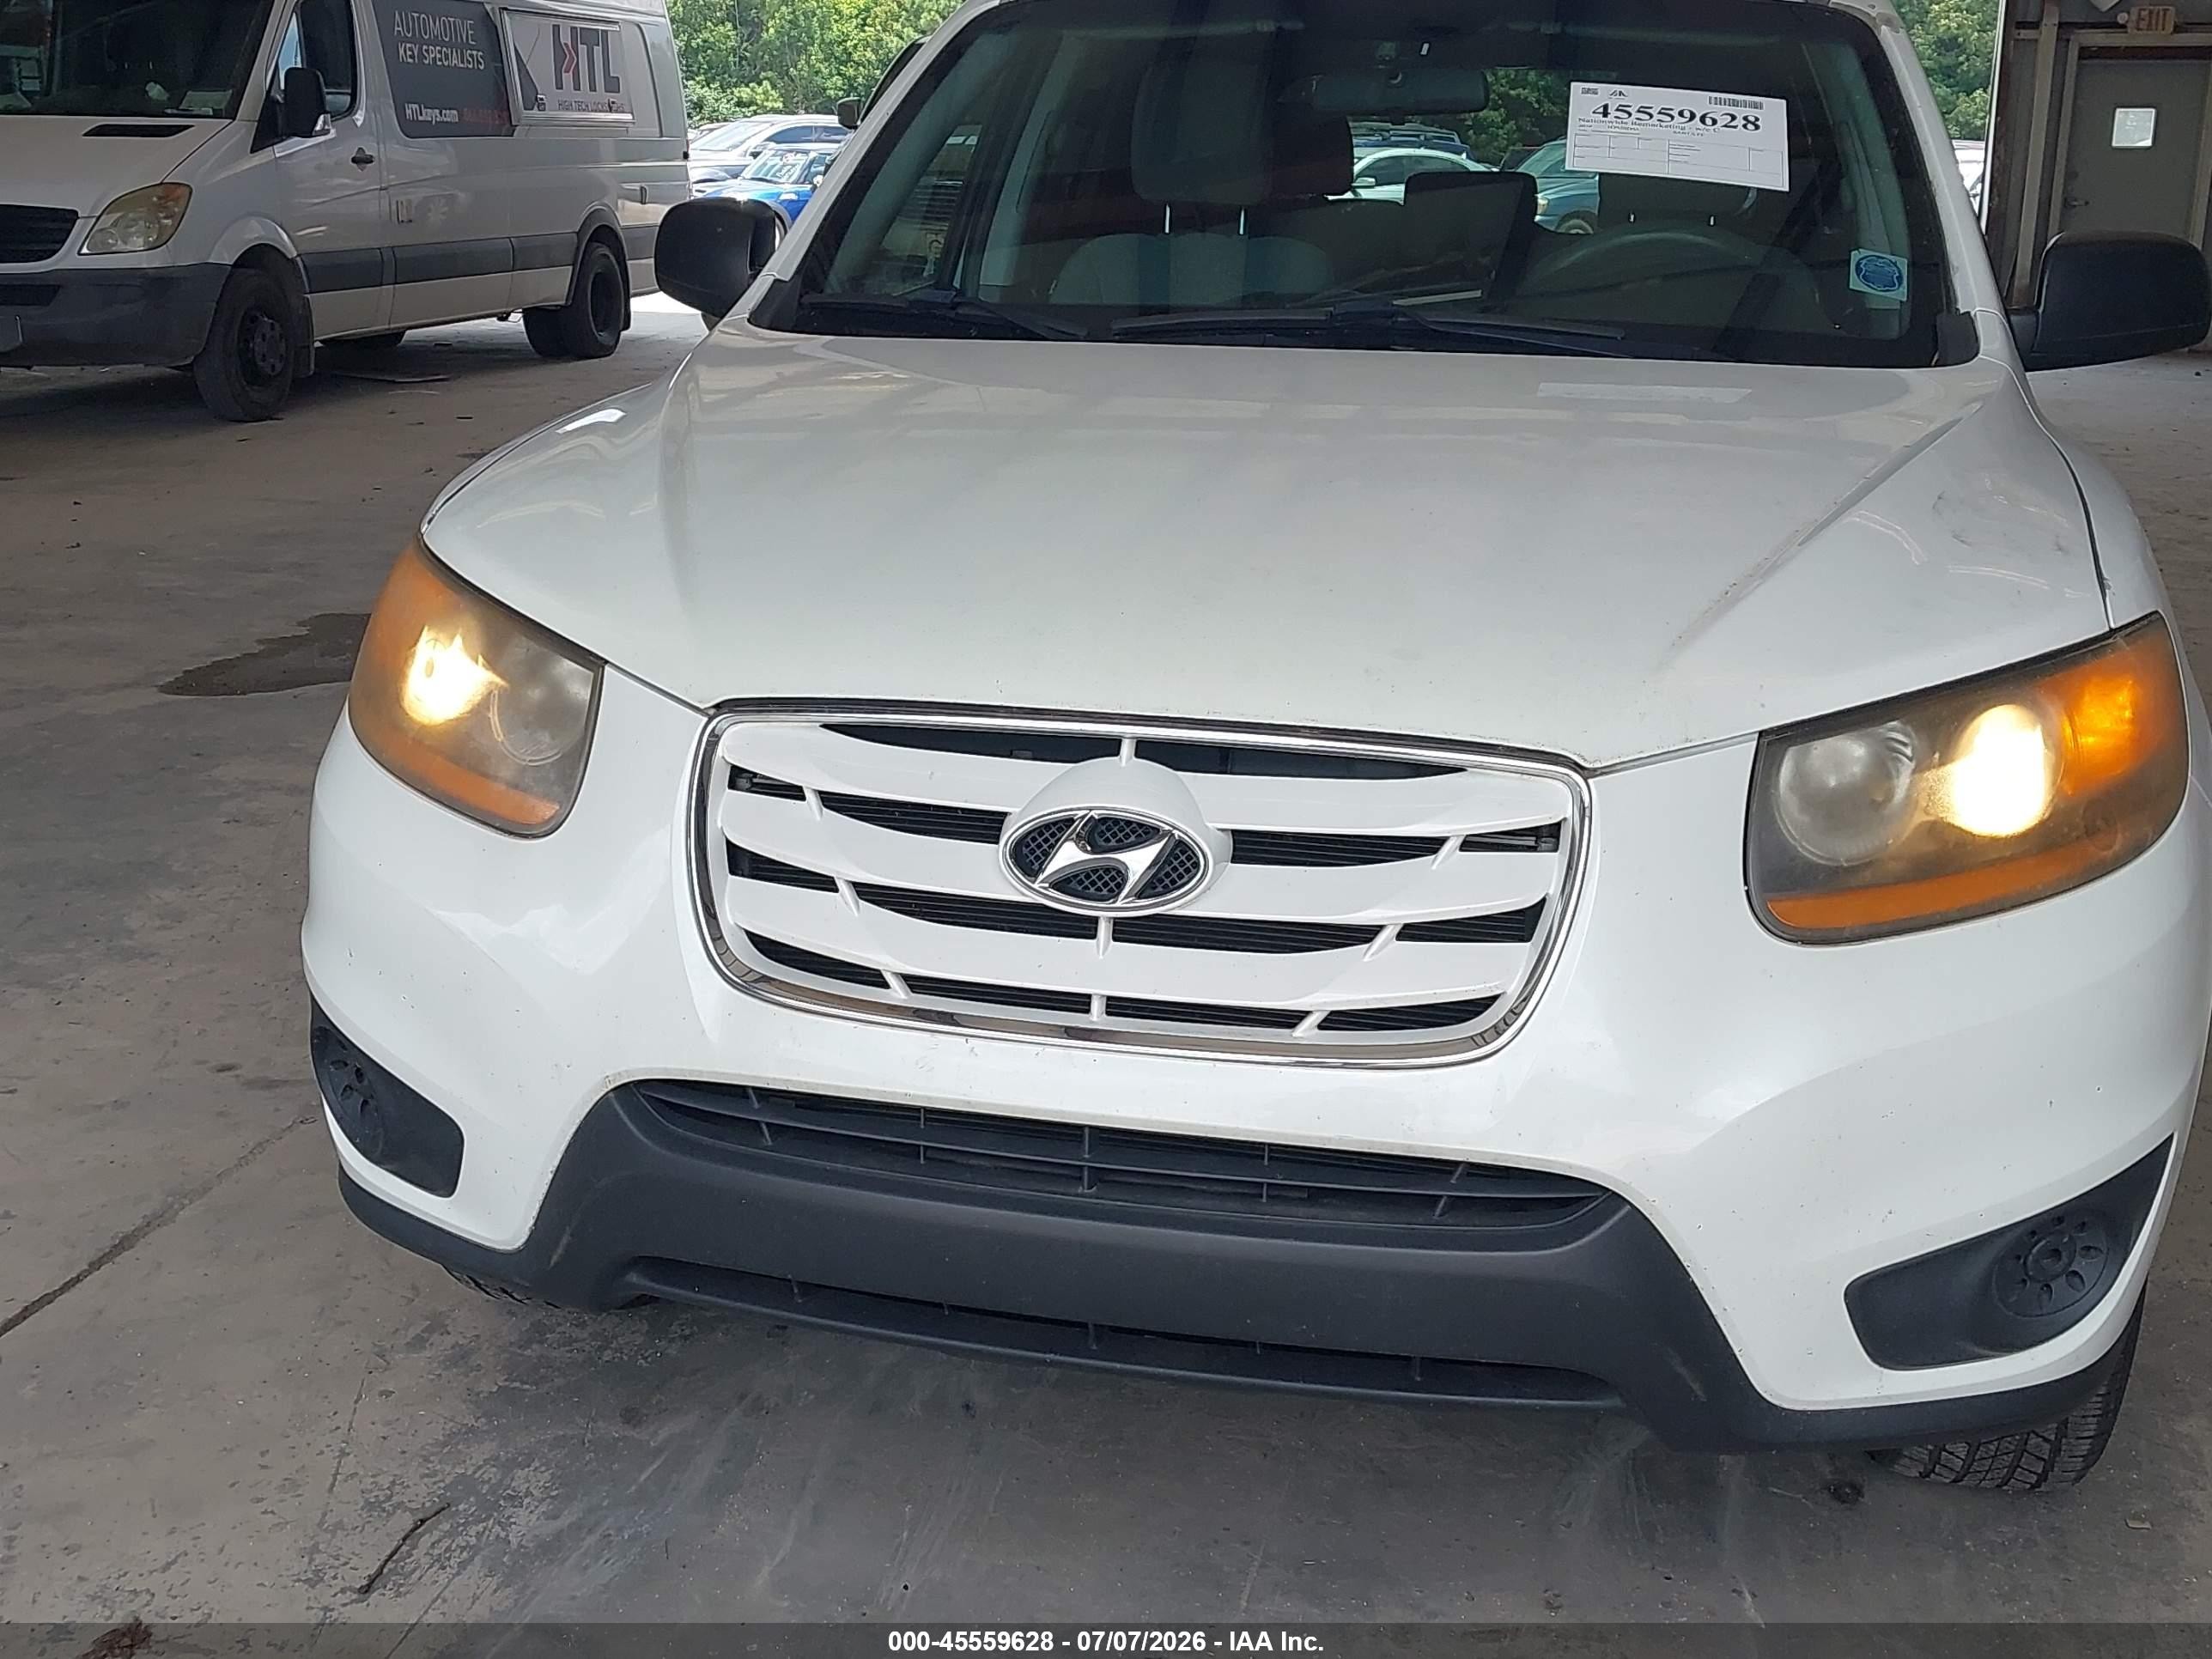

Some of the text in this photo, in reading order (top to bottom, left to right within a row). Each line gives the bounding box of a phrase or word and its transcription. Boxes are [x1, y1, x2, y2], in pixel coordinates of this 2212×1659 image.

[393, 10, 477, 45] AUTOMOTIVE
[2136, 9, 2170, 31] EXIT
[398, 41, 485, 70] KEY SPECIALISTS
[552, 24, 621, 94] HTL
[404, 103, 459, 125] HTLkeys.com
[574, 100, 590, 111] TECH
[1591, 101, 1761, 131] 45559628
